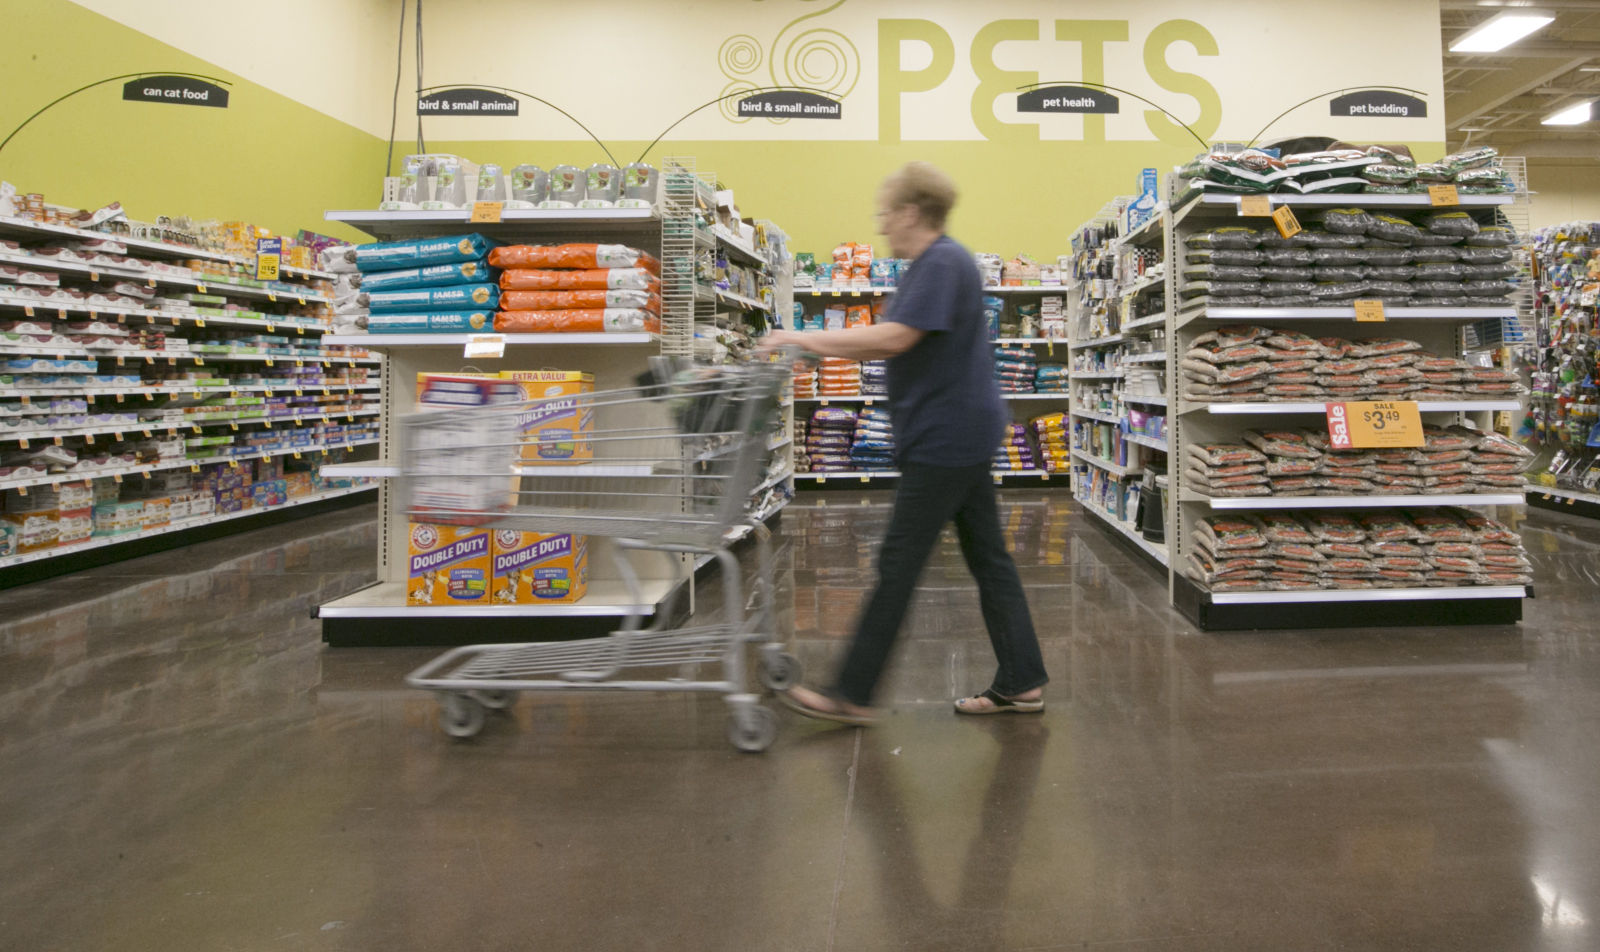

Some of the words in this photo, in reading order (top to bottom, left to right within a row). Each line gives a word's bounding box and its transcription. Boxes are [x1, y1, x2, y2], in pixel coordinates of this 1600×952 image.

[877, 18, 1223, 145] PETS
[143, 87, 162, 96] can
[164, 89, 181, 98] cat
[183, 88, 208, 100] food
[419, 100, 439, 110] bird
[441, 100, 449, 110] &
[452, 100, 479, 110] small
[481, 100, 516, 110] animal
[741, 101, 762, 111] bird
[764, 102, 772, 112] &
[774, 102, 801, 112] small
[804, 103, 839, 113] animal
[1043, 98, 1060, 108] pet
[1063, 97, 1095, 107] health
[1350, 104, 1367, 115] pet
[1368, 103, 1408, 116] bedding
[512, 372, 538, 381] EXTRA
[541, 372, 567, 380] VALUE
[544, 399, 574, 416] DUTY
[1329, 405, 1349, 445] Sale
[413, 547, 454, 570] DOUBLE
[456, 537, 485, 555] DUTY
[497, 546, 538, 570] DOUBLE
[540, 536, 569, 555] DUTY
